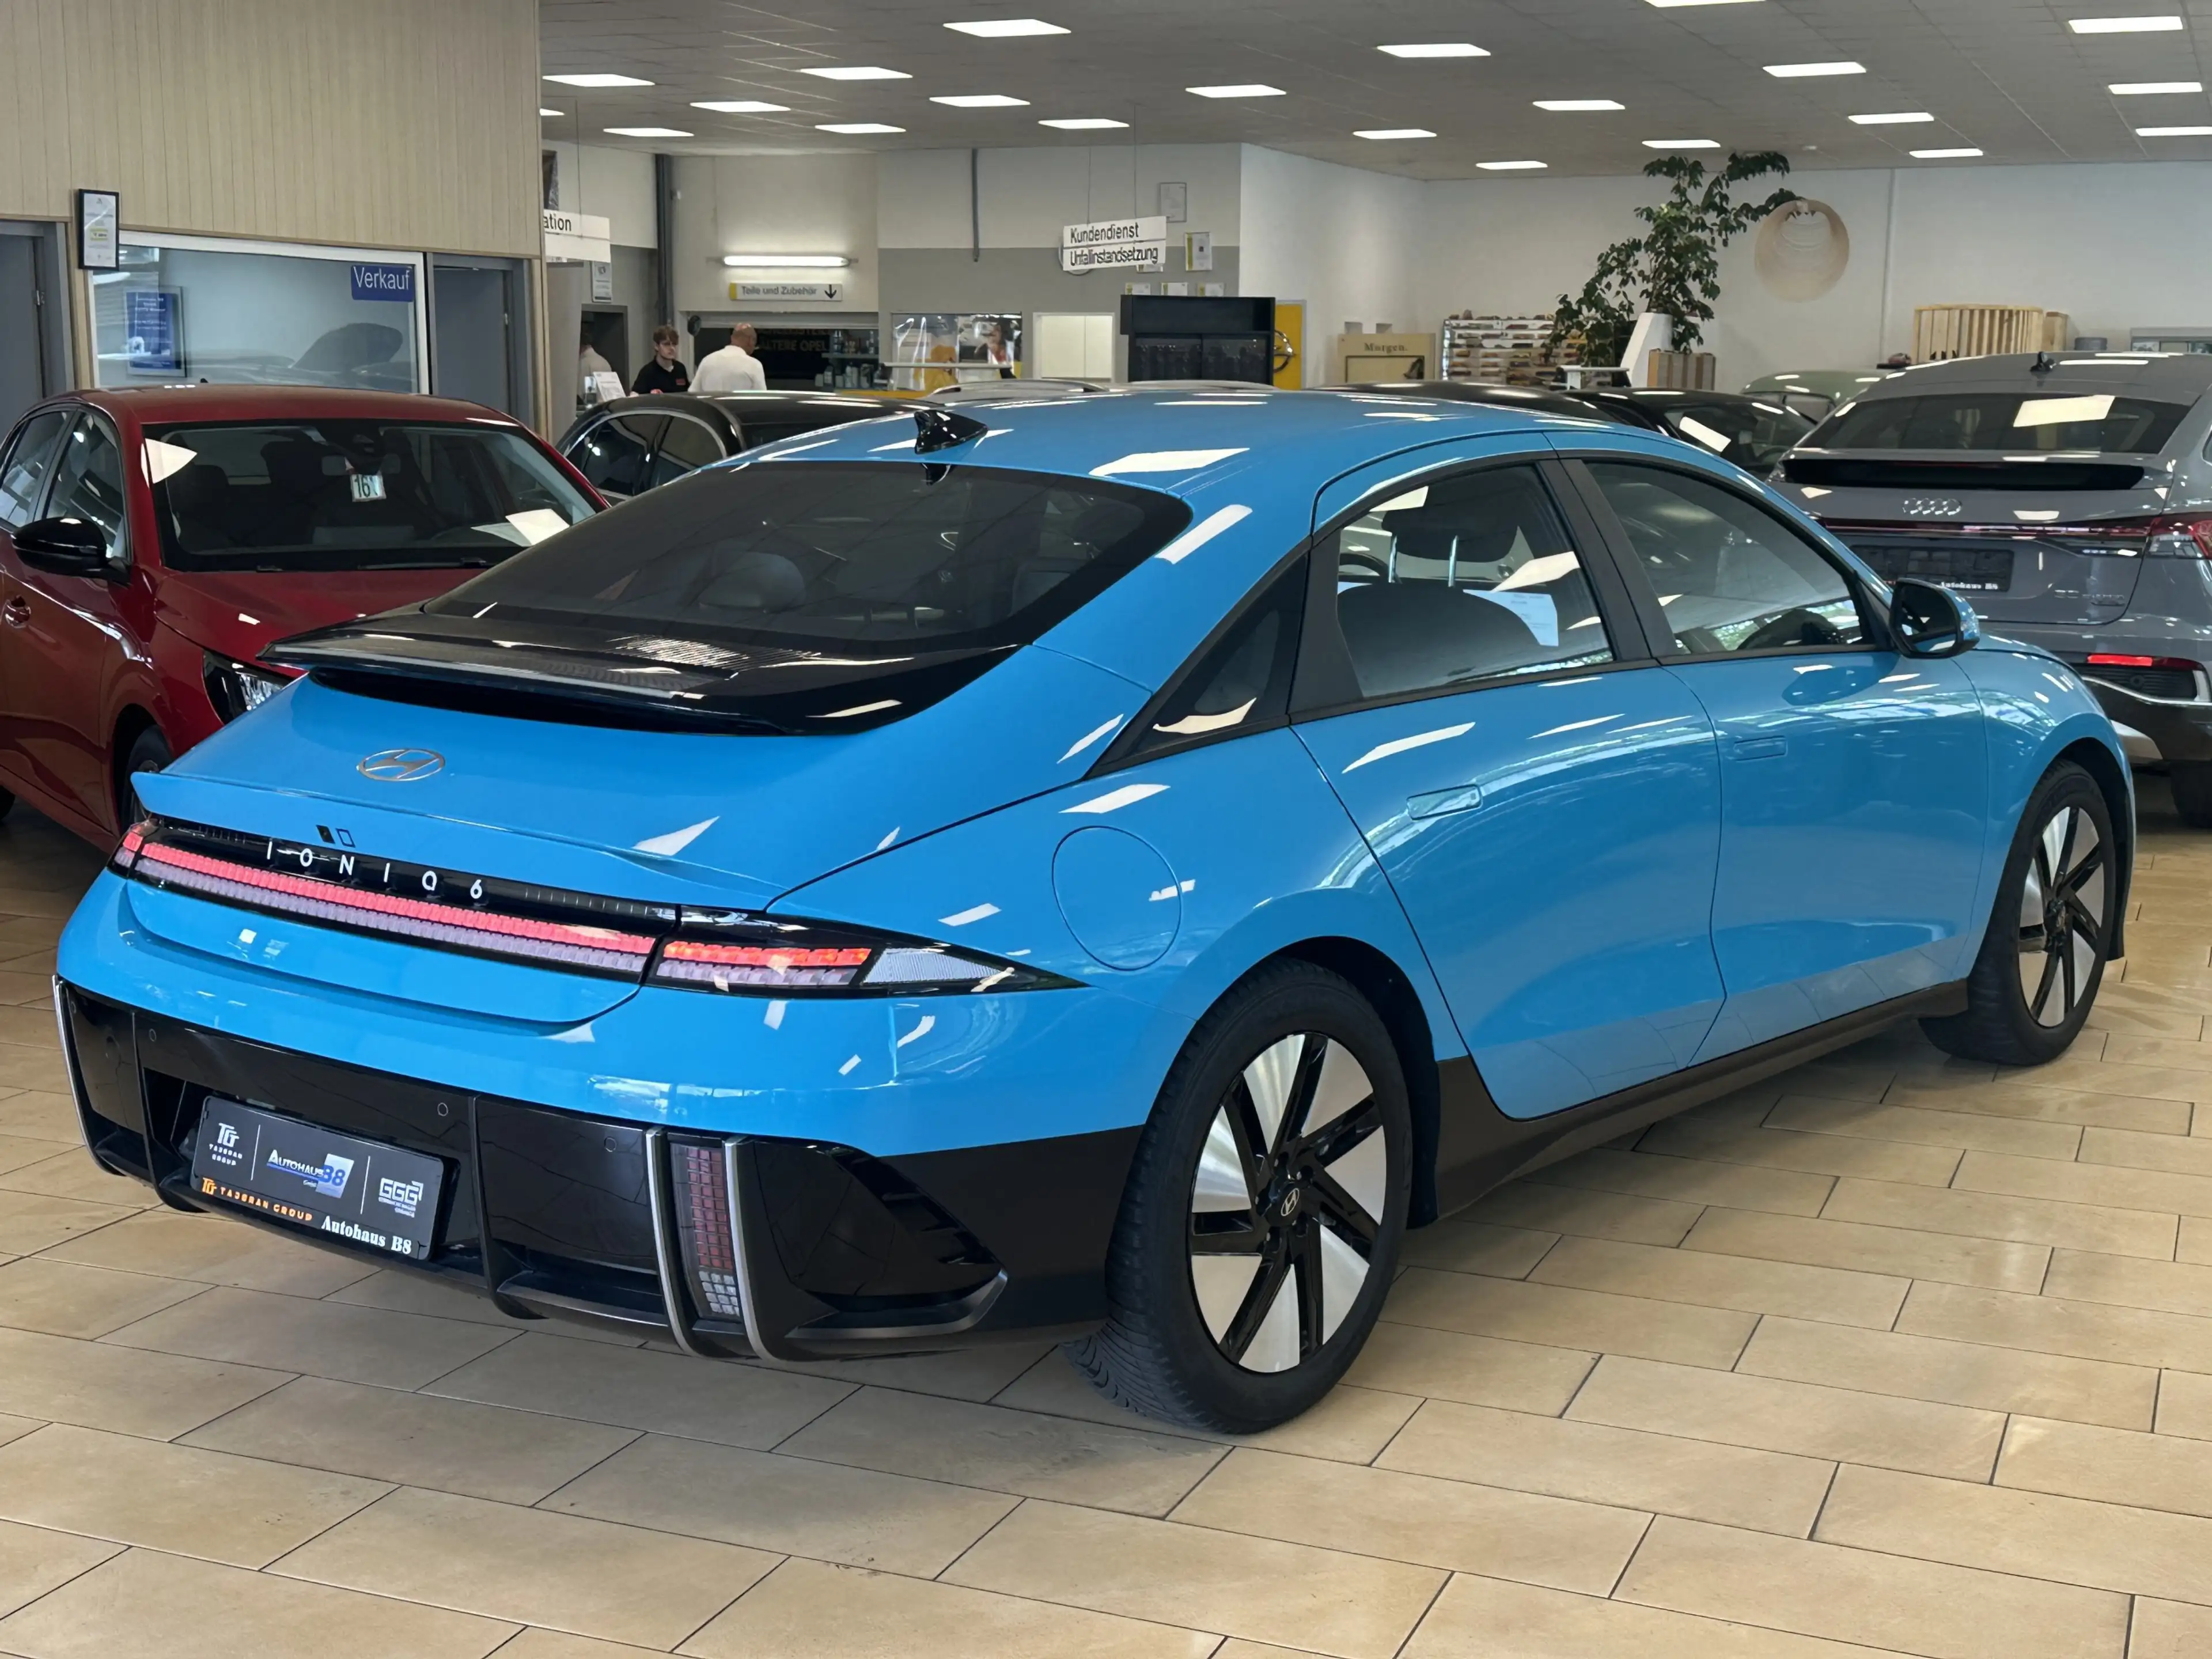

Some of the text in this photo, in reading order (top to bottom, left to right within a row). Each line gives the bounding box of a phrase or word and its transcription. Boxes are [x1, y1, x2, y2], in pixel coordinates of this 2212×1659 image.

[1070, 222, 1139, 244] Kundendienst
[353, 266, 410, 290] Verkauf
[741, 286, 817, 296] Teile und Zubehör
[267, 840, 483, 899] IONIQ 6
[273, 1203, 313, 1221] GROUP
[321, 1215, 412, 1255] Autohaus B8
